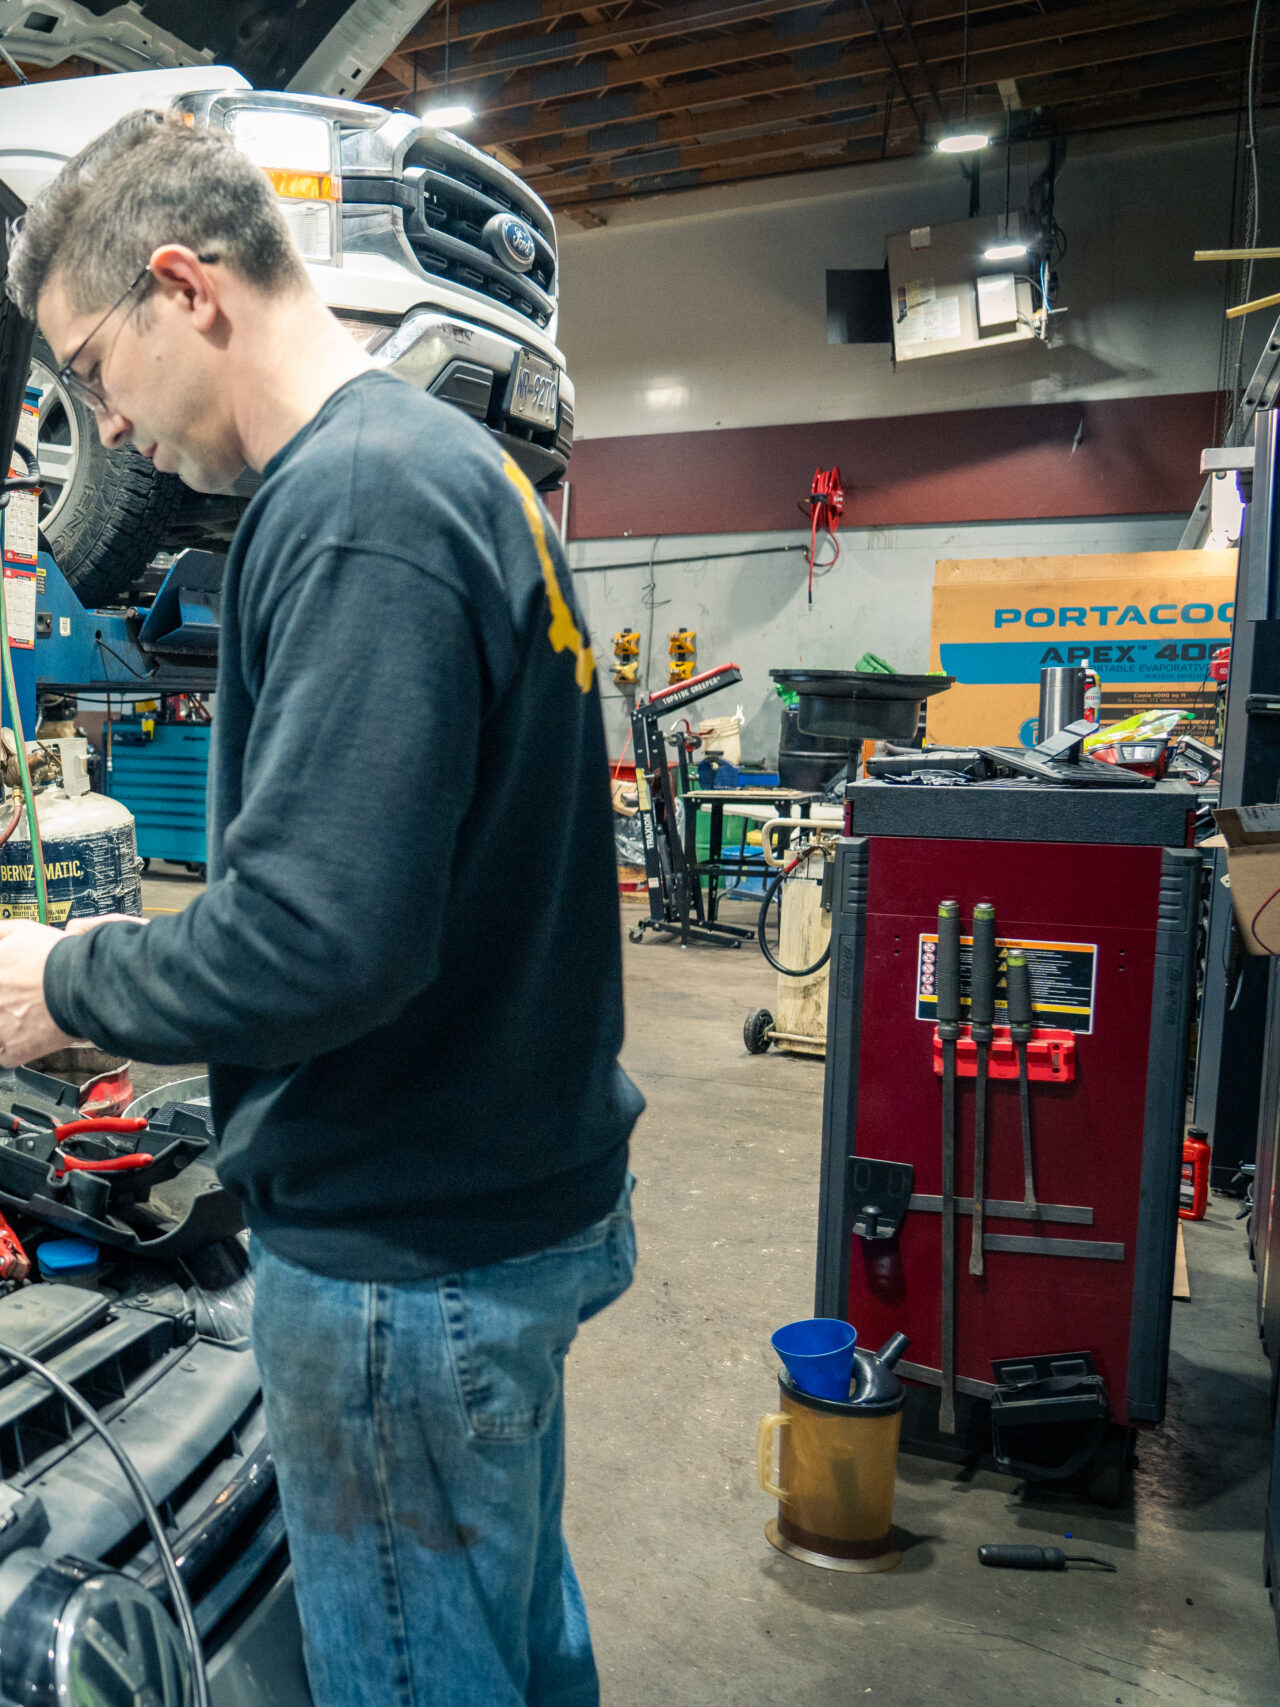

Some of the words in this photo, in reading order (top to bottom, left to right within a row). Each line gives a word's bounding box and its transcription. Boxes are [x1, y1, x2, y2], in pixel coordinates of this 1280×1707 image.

[513, 226, 530, 256] Ford
[662, 689, 689, 705] TOPSIDE
[643, 813, 654, 849] TRAXION
[0, 860, 82, 882] BERNZMATIC
